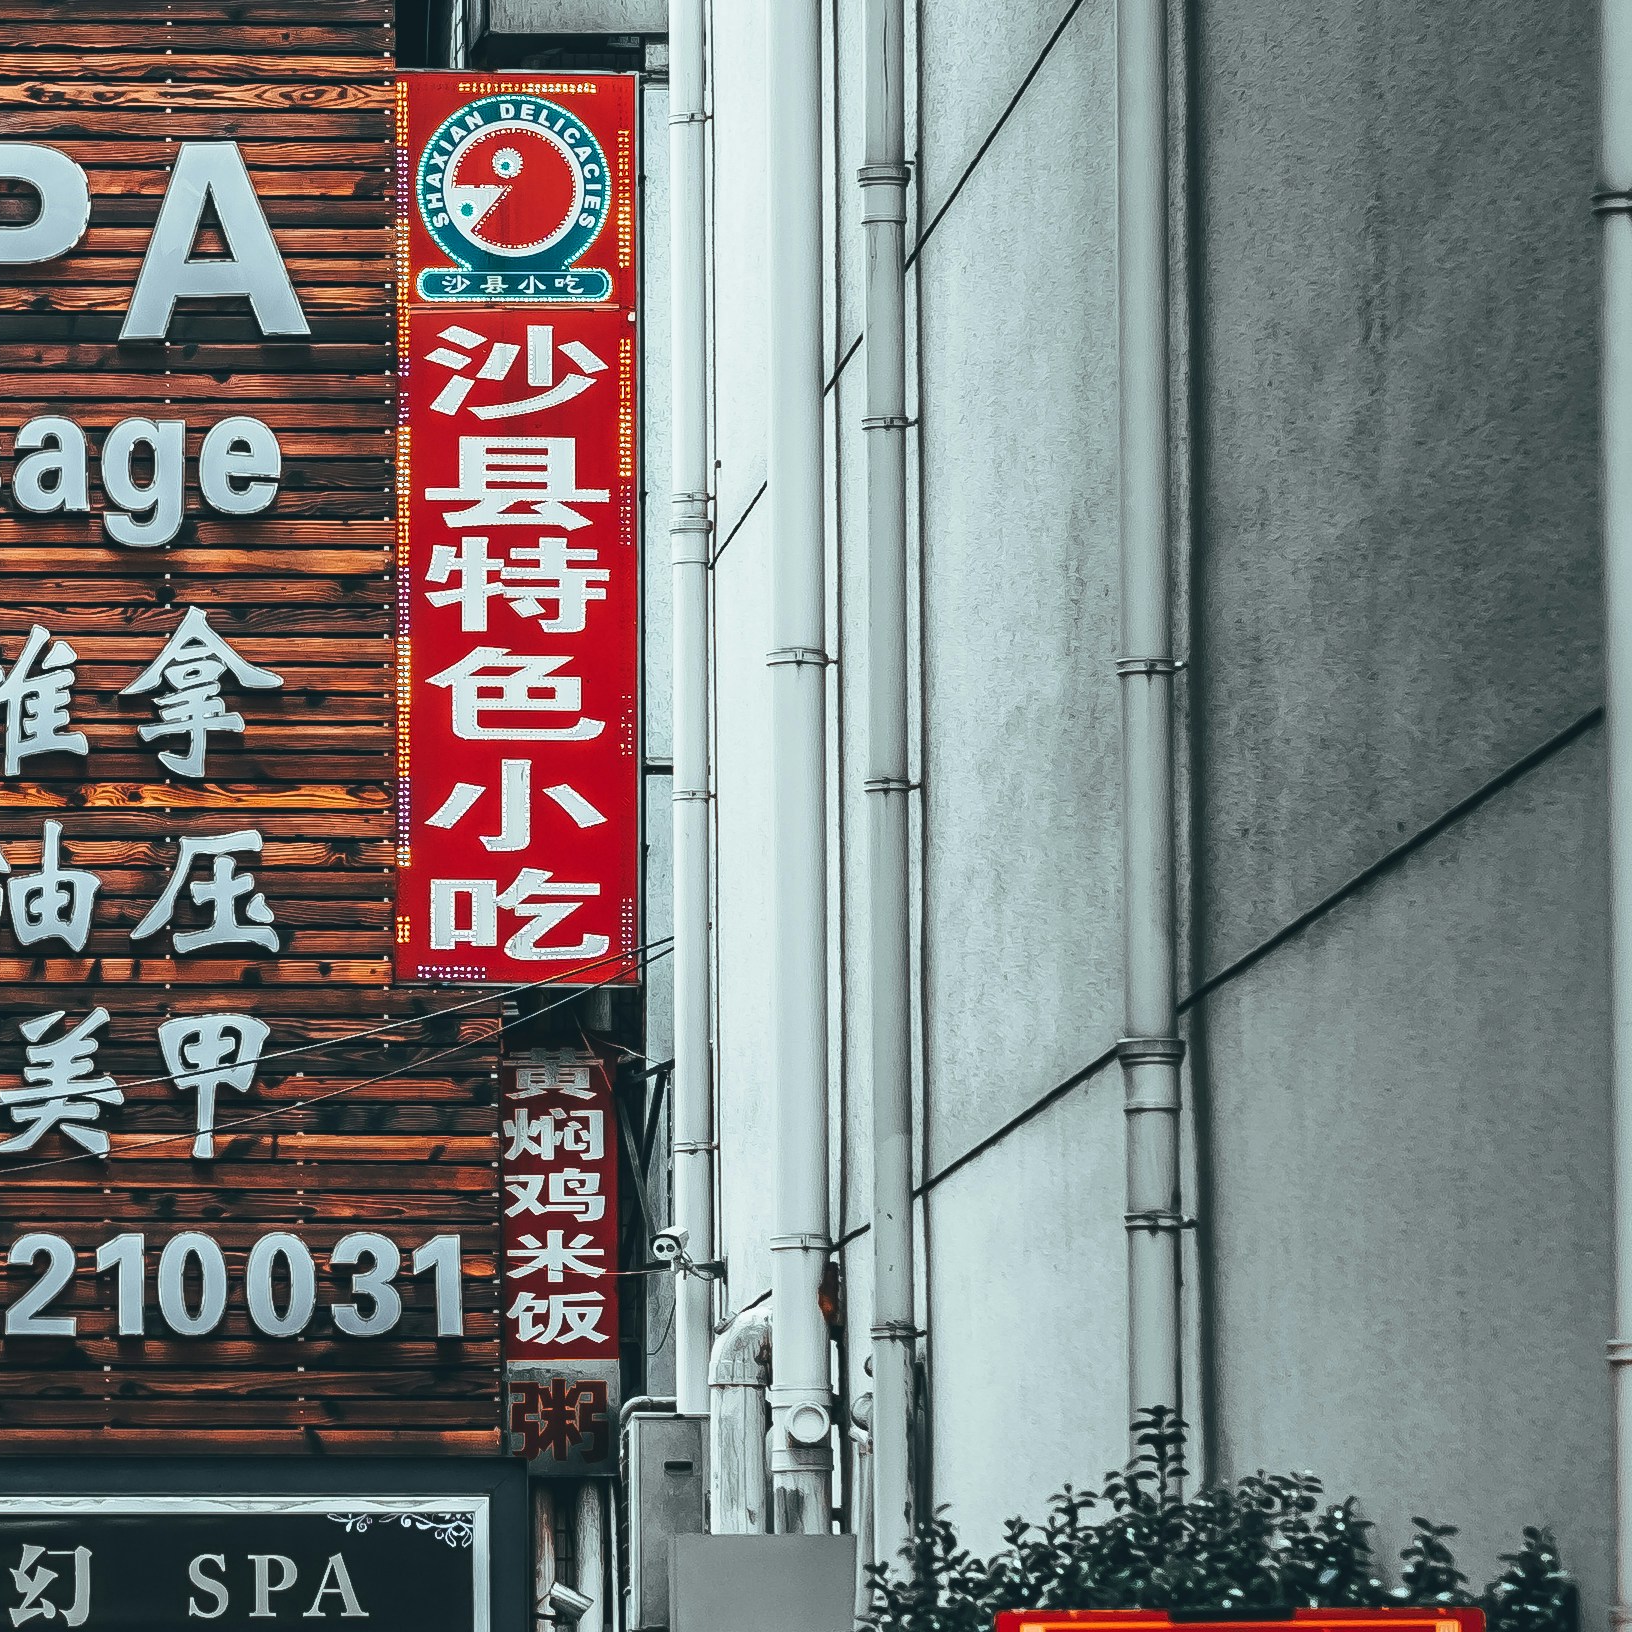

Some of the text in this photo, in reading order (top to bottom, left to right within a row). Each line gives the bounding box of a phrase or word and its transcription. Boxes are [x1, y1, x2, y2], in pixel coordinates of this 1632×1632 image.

[425, 102, 602, 230] SHAXIAN DELICACIES
[441, 274, 585, 295] 沙县小吃
[423, 323, 611, 963] 沙县特色小吃
[502, 1046, 611, 1346] 黄焖鸡米饭
[508, 1377, 610, 1464] 粥
[187, 1551, 371, 1619] SPA
